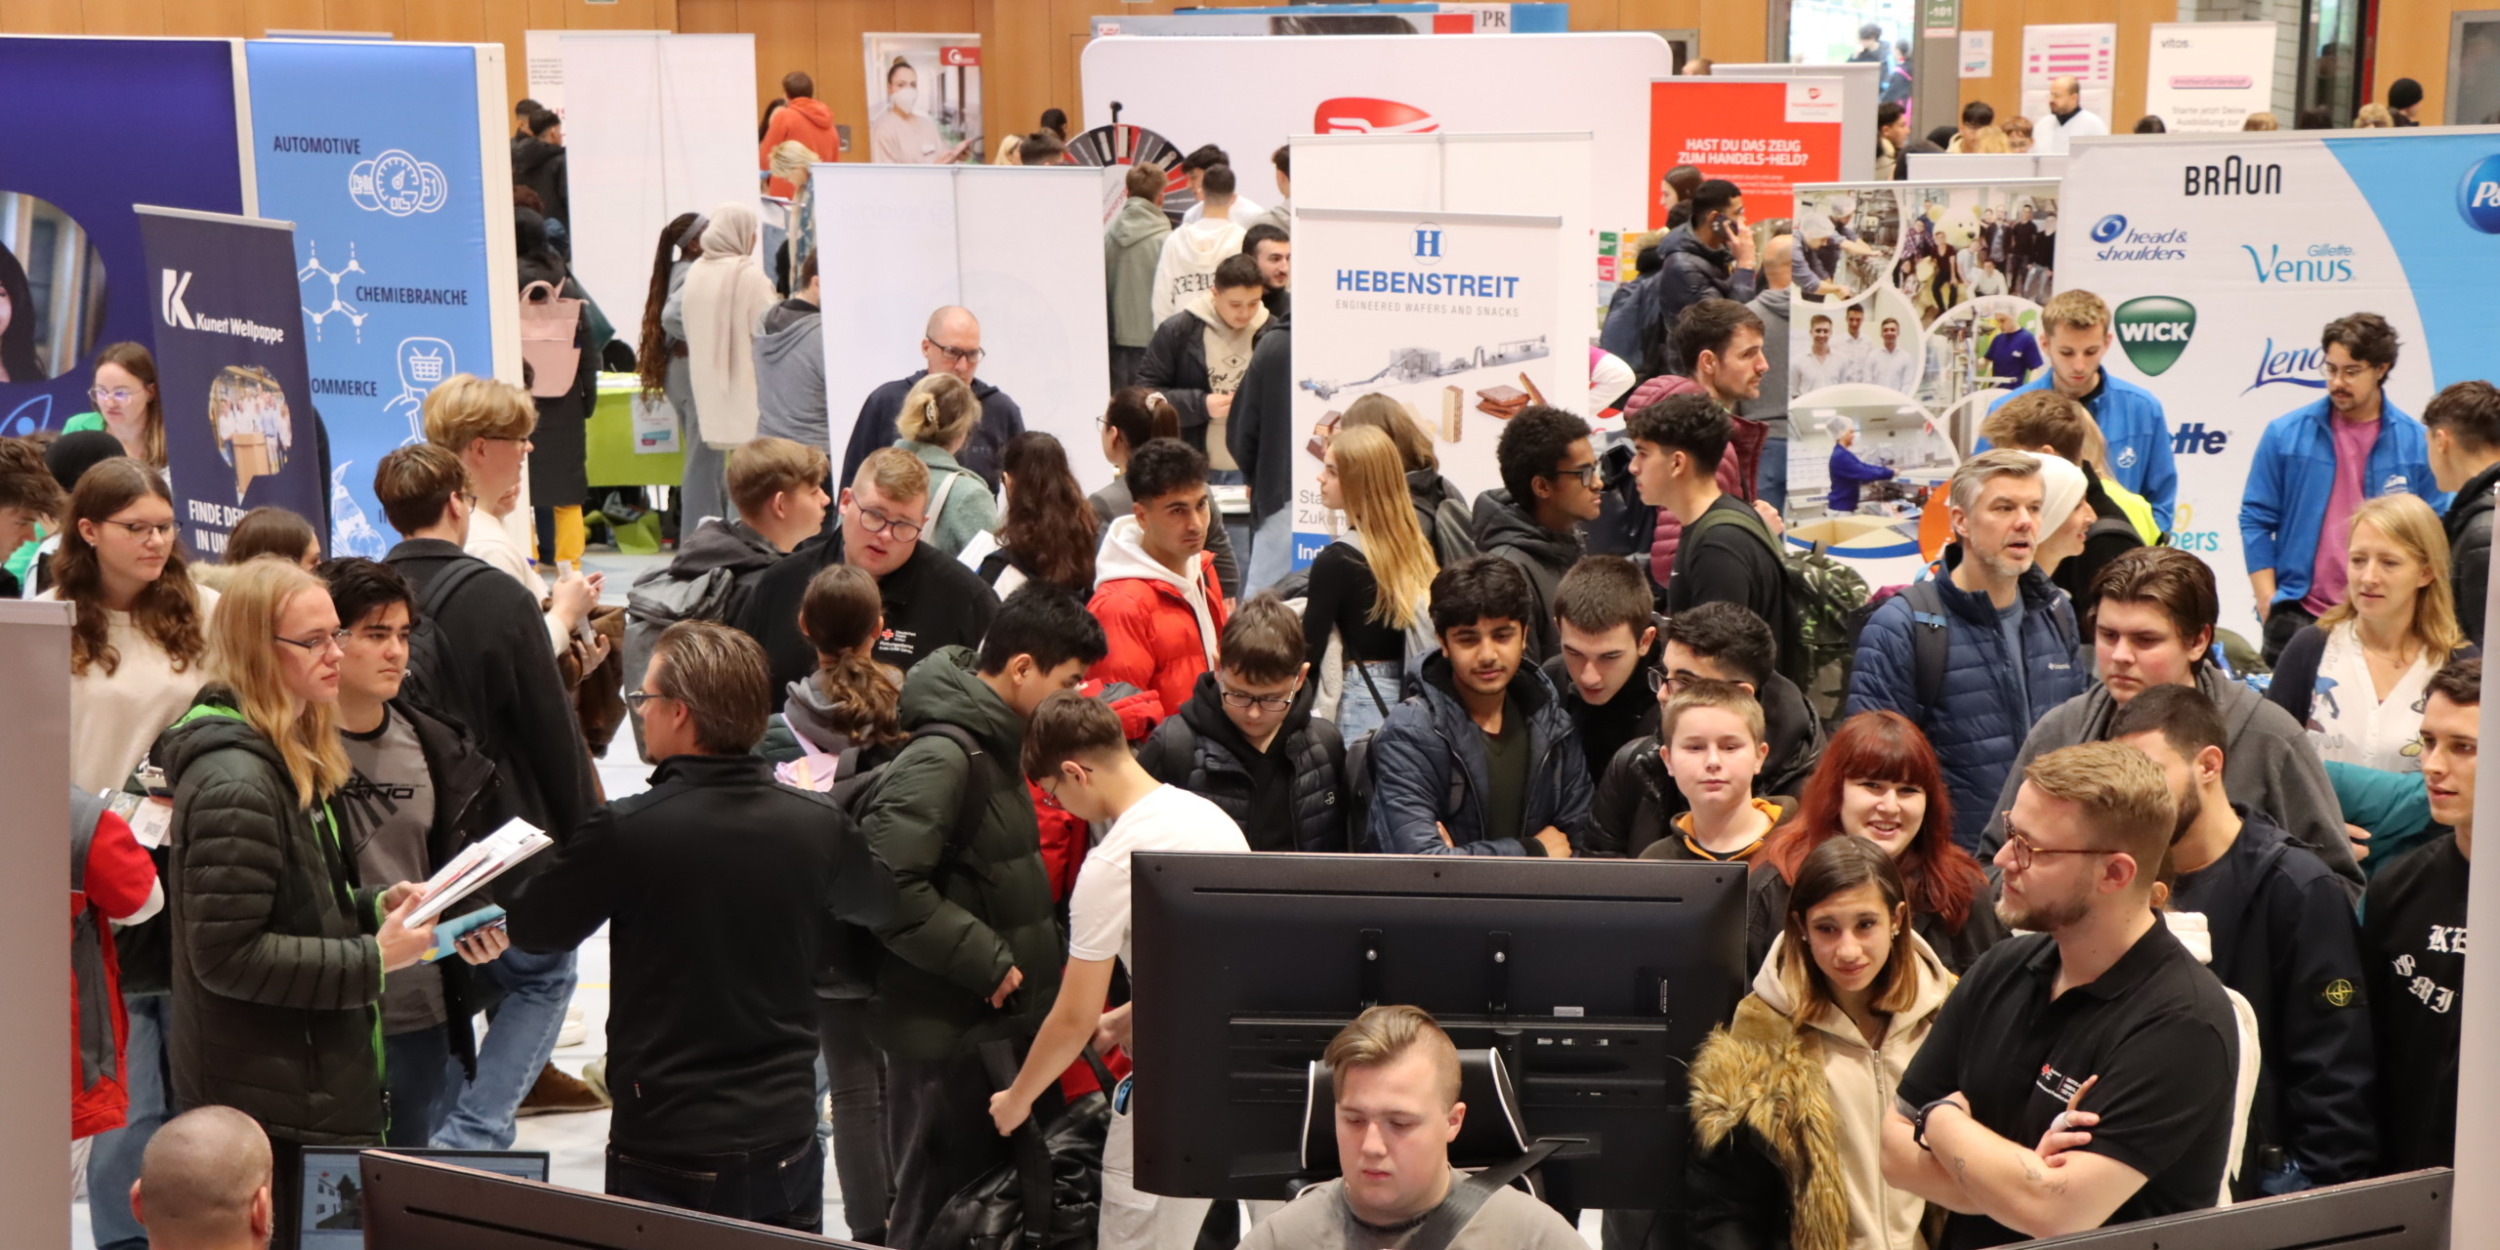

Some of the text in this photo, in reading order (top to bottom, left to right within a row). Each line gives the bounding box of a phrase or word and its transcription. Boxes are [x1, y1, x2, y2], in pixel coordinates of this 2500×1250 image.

[1482, 10, 1507, 28] PR
[273, 136, 361, 155] AUTOMOTIVE
[1685, 138, 1802, 152] HAST DU DAS ZEUG
[1677, 152, 1809, 166] ZUM HANDELS-HELD?
[2471, 181, 2500, 208] P&
[1414, 230, 1442, 257] H
[2125, 228, 2176, 244] head
[2096, 246, 2187, 262] shoulders
[2241, 244, 2353, 283] Venus
[1336, 269, 1519, 298] HEBENSTREIT
[356, 286, 468, 306] CHEMIEBRANCHE
[1336, 299, 1519, 317] ENGINEERED WAFERS AND SNACKS
[196, 312, 284, 345] Kunert Wellpappe
[2119, 322, 2190, 342] WICK
[2256, 337, 2327, 388] Leno
[311, 378, 378, 397] OMMERCE
[1299, 489, 1323, 505] Sta
[189, 499, 223, 526] FINDE
[195, 528, 230, 554] IN UN
[2427, 924, 2467, 954] KE
